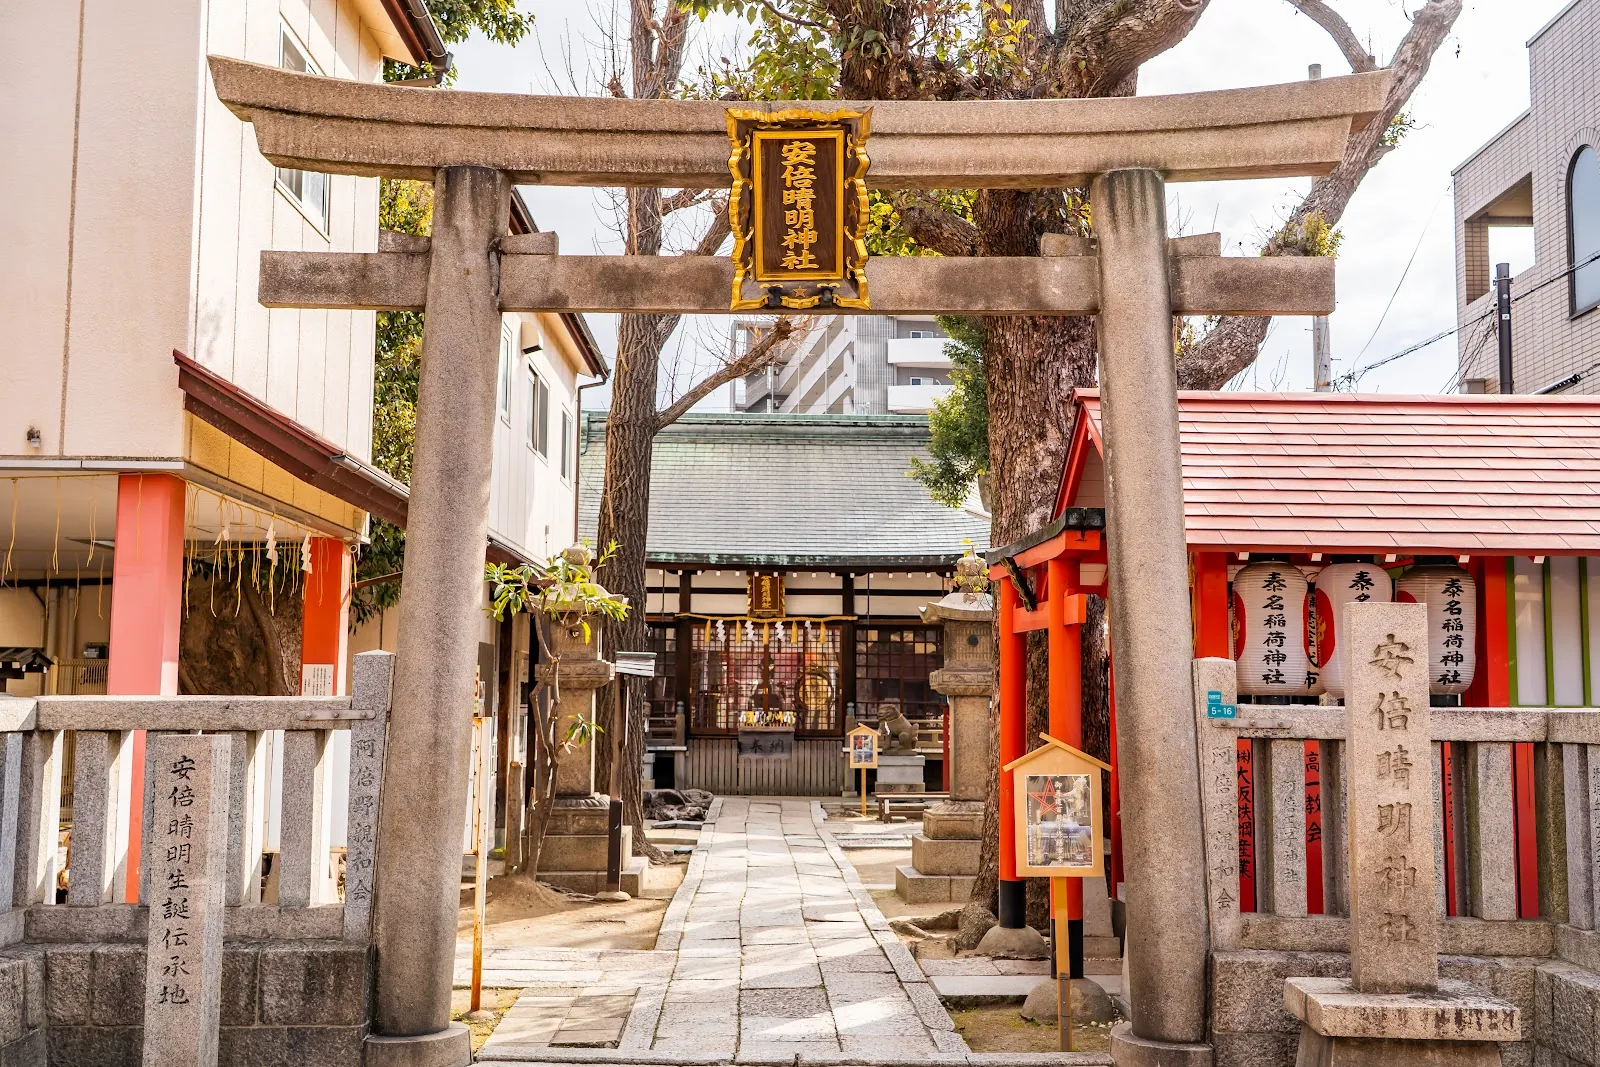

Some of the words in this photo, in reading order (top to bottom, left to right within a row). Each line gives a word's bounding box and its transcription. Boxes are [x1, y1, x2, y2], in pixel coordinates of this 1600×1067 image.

[781, 141, 819, 270] 安倍晴明神社
[1262, 571, 1287, 684] 泰名稲荷神社
[1437, 578, 1464, 685] 泰名稲荷神社
[1211, 707, 1232, 715] 5-16
[351, 739, 376, 901] 阿倍野親和会
[1211, 746, 1236, 909] 阿倍野親和会
[1368, 633, 1416, 943] 安倍晴明神社
[160, 755, 196, 1005] 安倍晴明生誕伝承地
